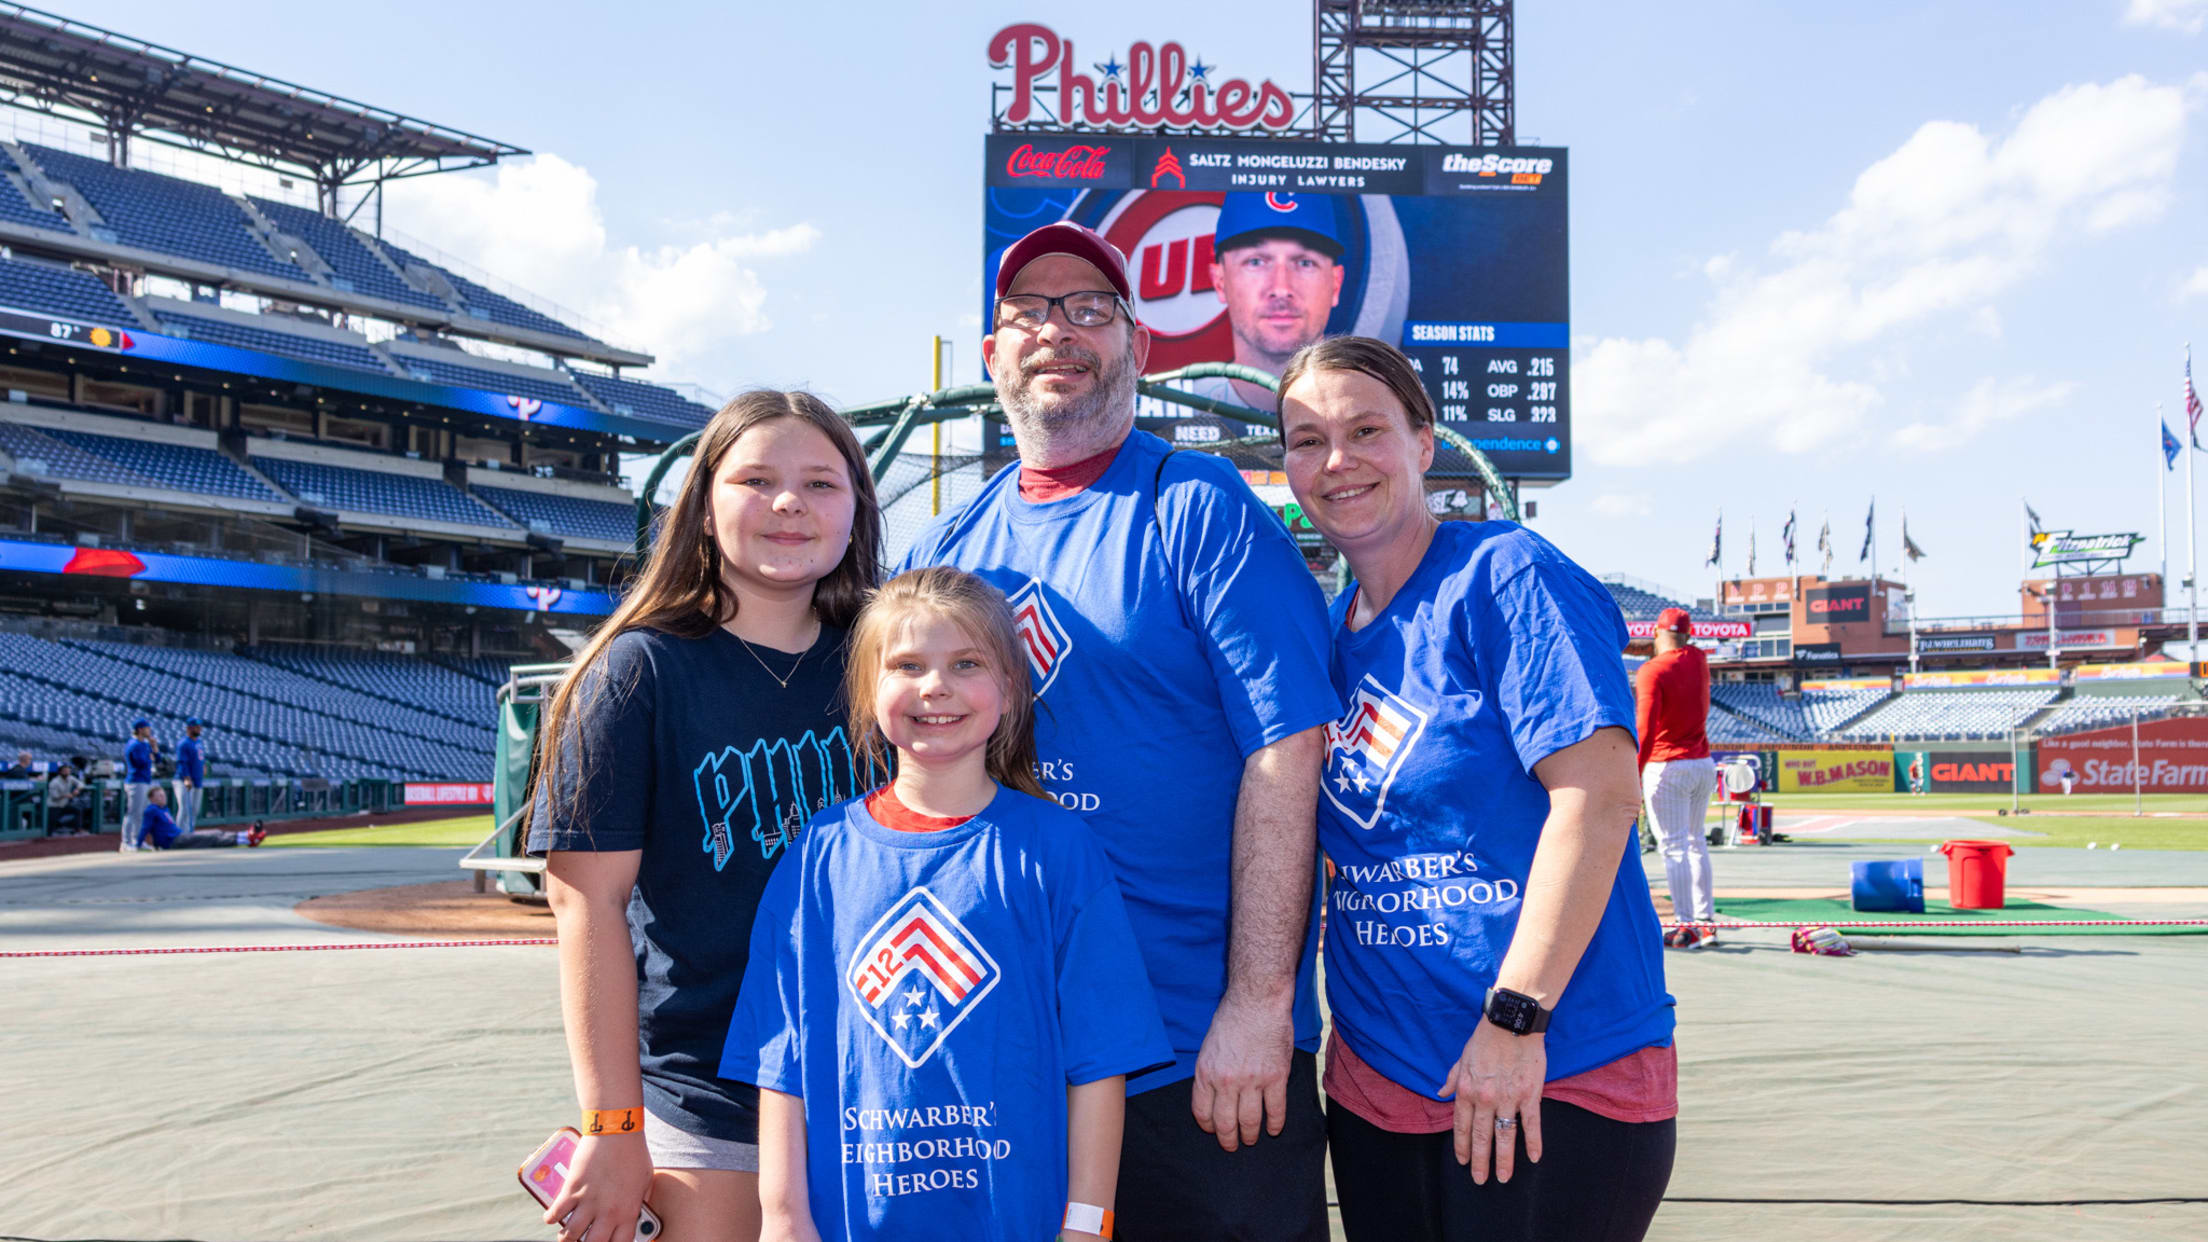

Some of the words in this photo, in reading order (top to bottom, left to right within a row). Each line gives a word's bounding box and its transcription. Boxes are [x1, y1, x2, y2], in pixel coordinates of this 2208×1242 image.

[987, 22, 1294, 129] Phillies
[1189, 154, 1231, 167] SALTZ
[1237, 155, 1329, 169] MONGELUZZI
[1334, 157, 1406, 171] BENDESKY
[1442, 153, 1553, 174] theScore
[1231, 174, 1286, 186] INJURY
[1297, 175, 1366, 187] LAWYERS
[1412, 325, 1457, 341] SEASON
[1458, 326, 1495, 342] STATS
[1441, 356, 1459, 376] 74
[1487, 360, 1518, 374] AVG
[1526, 357, 1554, 377] .215
[1442, 381, 1469, 400] 14%
[1487, 384, 1518, 398] OBP
[1442, 405, 1468, 422] 11%
[1487, 408, 1516, 422] SLG
[1175, 425, 1220, 441] NEED
[1810, 598, 1865, 613] GIANT
[1694, 623, 1748, 636] TOYOTA
[1930, 763, 2014, 782] GIANT
[844, 1101, 998, 1131] SCHWARBER'
[872, 1168, 979, 1197] HEROES
